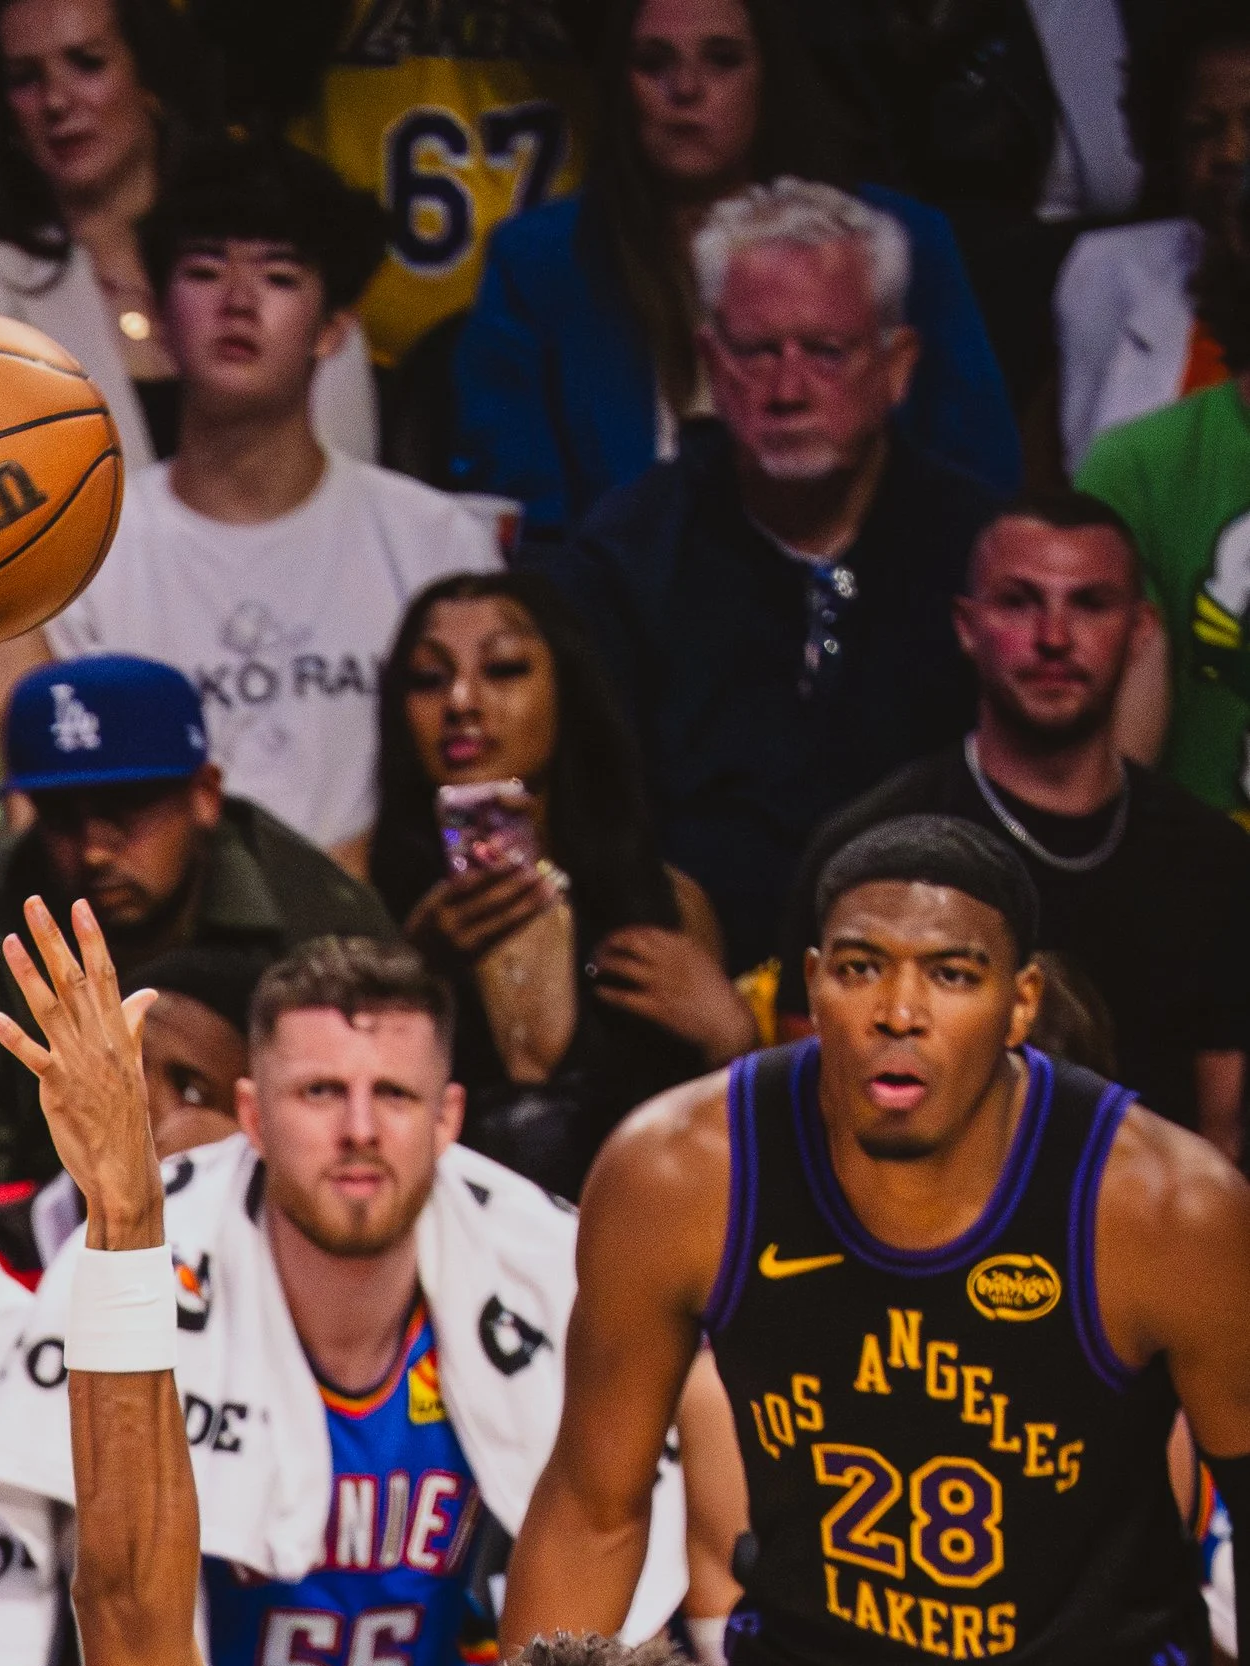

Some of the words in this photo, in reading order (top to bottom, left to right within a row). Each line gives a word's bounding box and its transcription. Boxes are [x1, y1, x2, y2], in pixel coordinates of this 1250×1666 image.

[382, 100, 568, 276] 67
[750, 1373, 825, 1461] LOS
[853, 1306, 1085, 1494] ANGELES
[811, 1443, 1005, 1588] 28
[824, 1562, 1018, 1660] LAKERS
